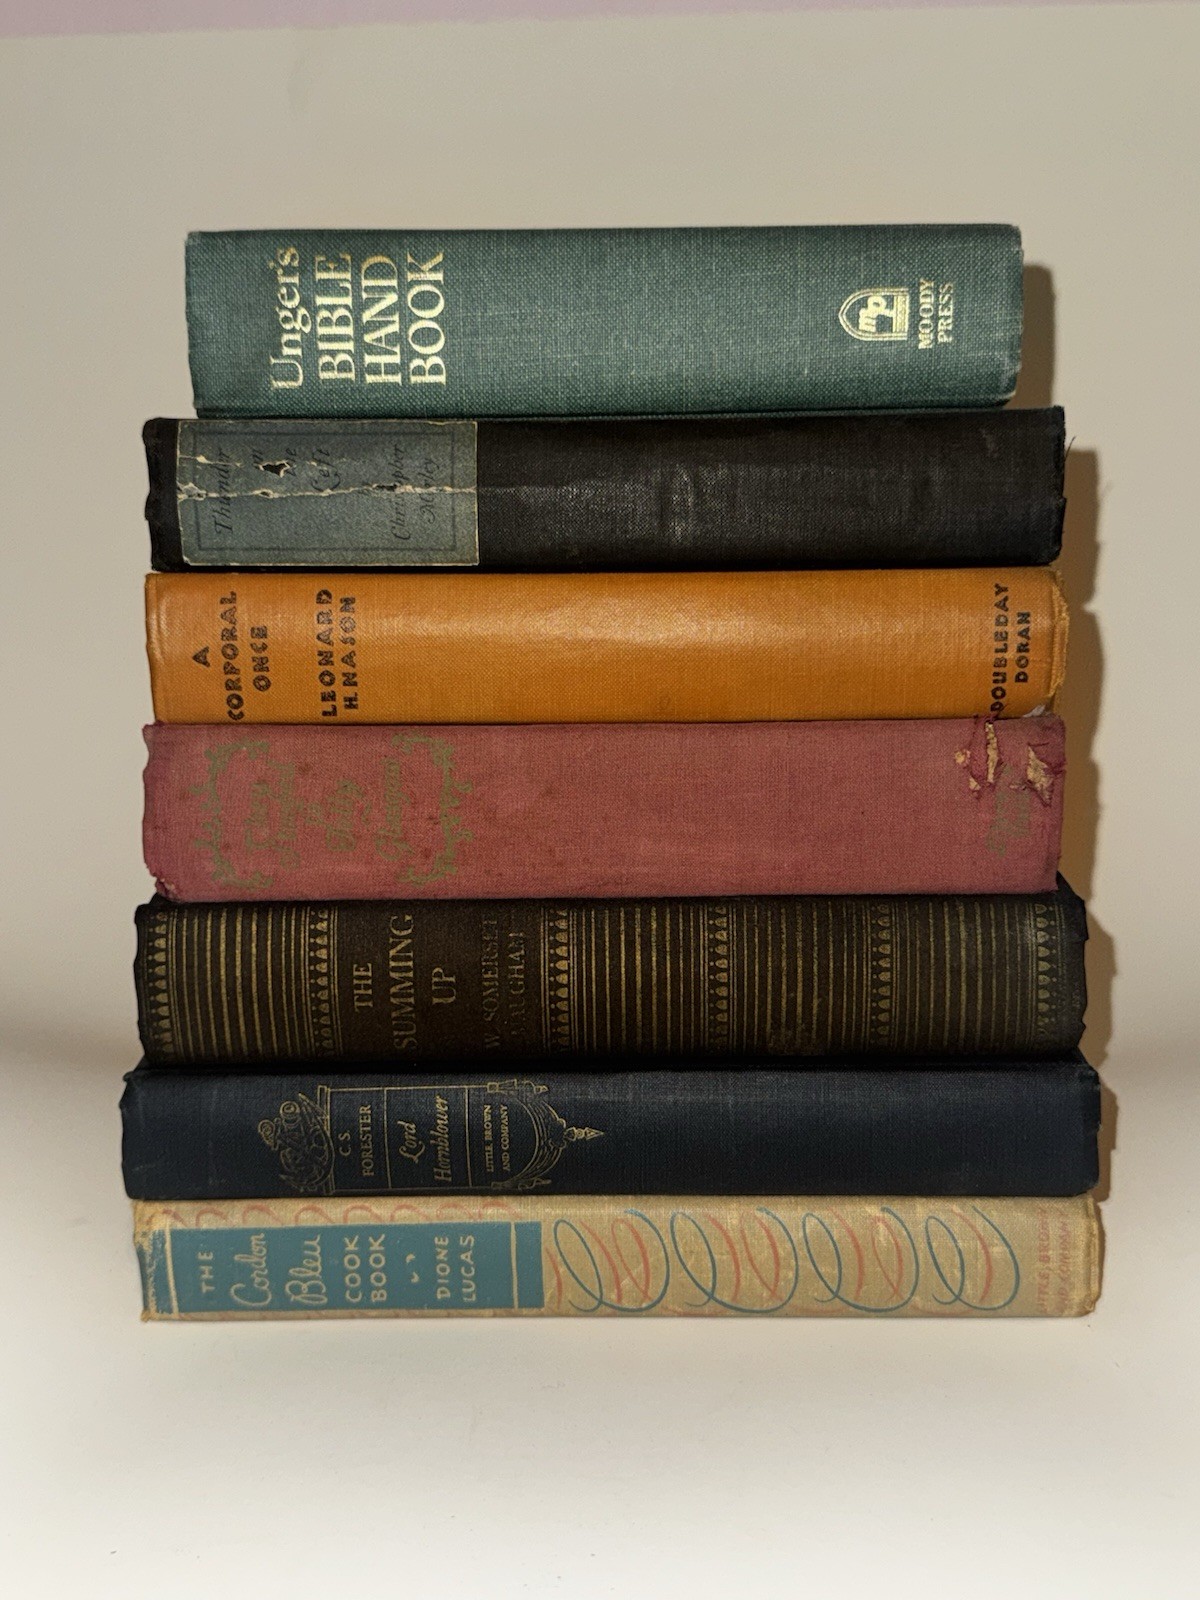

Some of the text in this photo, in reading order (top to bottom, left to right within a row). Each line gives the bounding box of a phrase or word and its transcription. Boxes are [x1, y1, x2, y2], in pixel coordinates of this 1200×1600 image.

[269, 246, 312, 390] Unger's
[314, 253, 356, 381] BIBLE
[361, 254, 403, 386] HAND
[406, 251, 446, 385] BOOK
[918, 278, 935, 349] MOODY
[938, 283, 953, 343] PRESS
[418, 458, 439, 524] Mrley
[191, 646, 210, 667] A
[219, 591, 244, 720] CORPORAL
[250, 625, 271, 692] ONCE
[316, 588, 337, 717] LEONARD
[990, 583, 1009, 713] DOUBLEDAY
[1015, 612, 1030, 683] DORAN
[353, 963, 373, 1012] THE
[388, 914, 417, 1050] SUMMING
[431, 967, 456, 1005] UP
[481, 914, 499, 1022] SOMERSET
[359, 1105, 374, 1176] FORESTER
[397, 1120, 425, 1164] Lord
[430, 1095, 452, 1182] Hornblower
[484, 1104, 492, 1141] BROWN
[500, 1104, 510, 1171] AND COMPANY
[197, 1251, 215, 1294] THE
[229, 1232, 272, 1306] Cordon
[285, 1234, 329, 1305] Bleu
[344, 1235, 362, 1302] COOK
[368, 1233, 387, 1302] BOOK
[434, 1235, 451, 1299] DIONE
[459, 1234, 477, 1302] LUCAS
